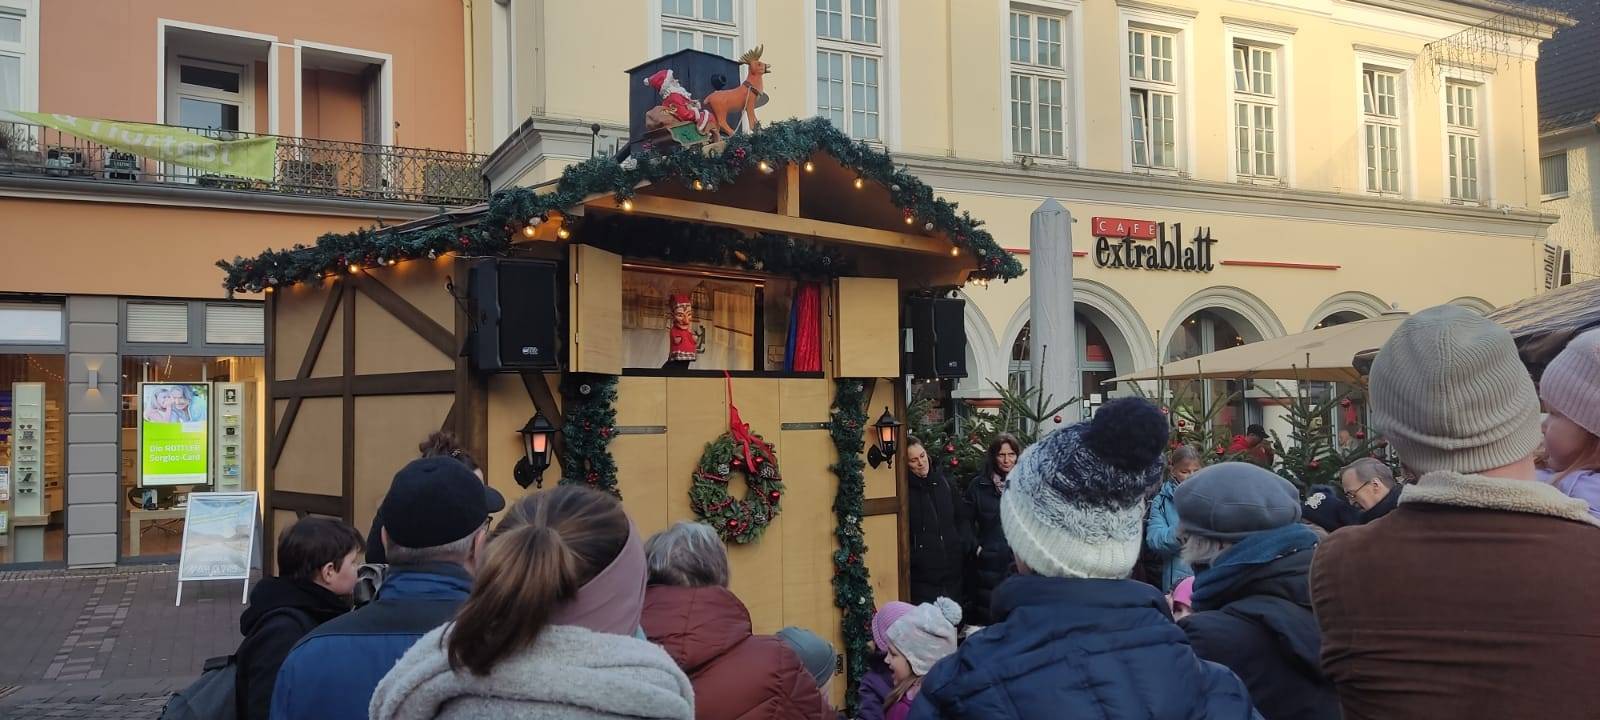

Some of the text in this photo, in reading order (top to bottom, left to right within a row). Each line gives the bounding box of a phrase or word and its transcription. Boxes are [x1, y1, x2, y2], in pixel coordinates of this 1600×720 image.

[1093, 221, 1218, 273] extrablatt
[1099, 220, 1155, 235] CAFE
[1544, 243, 1555, 289] trablatt
